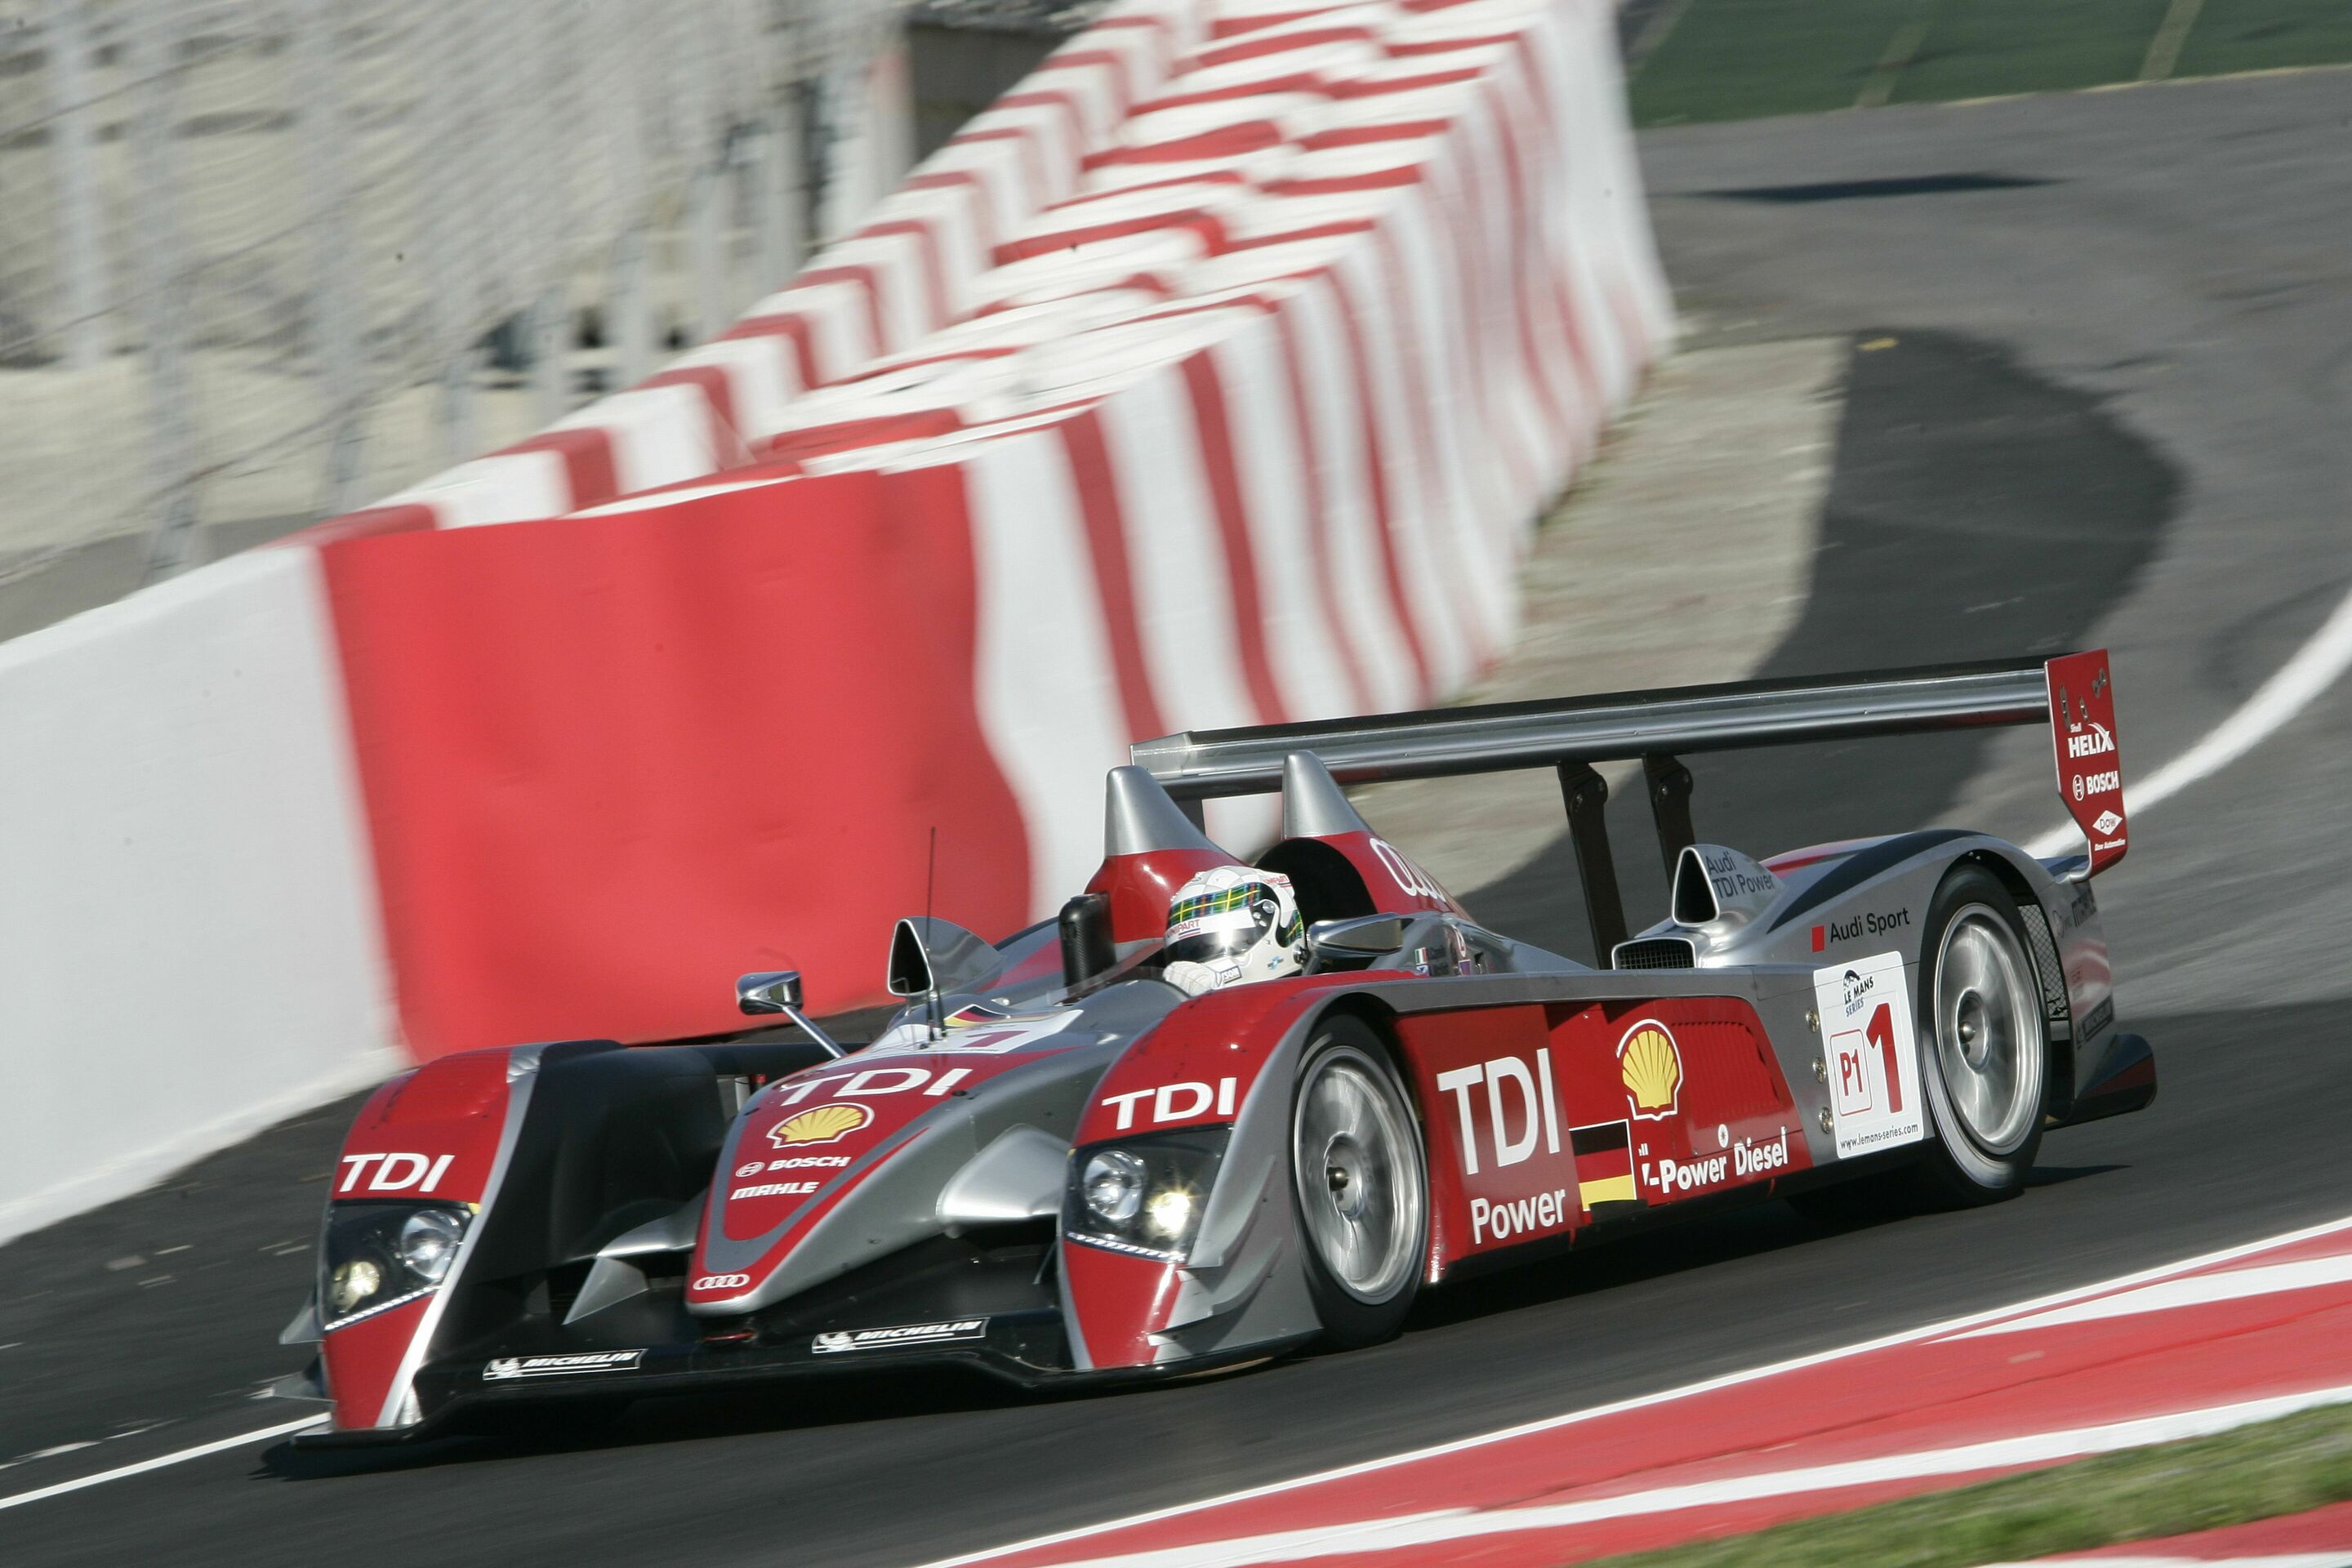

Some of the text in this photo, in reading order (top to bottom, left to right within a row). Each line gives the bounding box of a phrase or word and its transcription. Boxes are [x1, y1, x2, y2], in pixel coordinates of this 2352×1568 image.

[2068, 730, 2115, 758] HELIX
[2086, 770, 2119, 795] BOSCH
[1705, 852, 1736, 875] Audi
[1712, 871, 1775, 899] TDI Power
[1830, 907, 1909, 942] Audi Sport
[1844, 976, 1873, 1004] LE MANS
[1846, 997, 1864, 1018] SERIES
[1866, 1002, 1903, 1114] 1
[780, 1067, 973, 1107] TDI
[1839, 1049, 1863, 1097] P1
[1101, 1077, 1237, 1130] TDI
[1437, 1047, 1561, 1176] TDI
[1840, 1122, 1918, 1151] www.lemans-series.com
[767, 1156, 851, 1171] BOSCH
[1734, 1125, 1788, 1177] Diesel
[339, 1152, 456, 1192] TDI
[730, 1181, 819, 1200] MAHLE
[1471, 1188, 1566, 1245] Power
[854, 1321, 982, 1340] MICHELIN
[523, 1352, 637, 1367] MICHELIN
